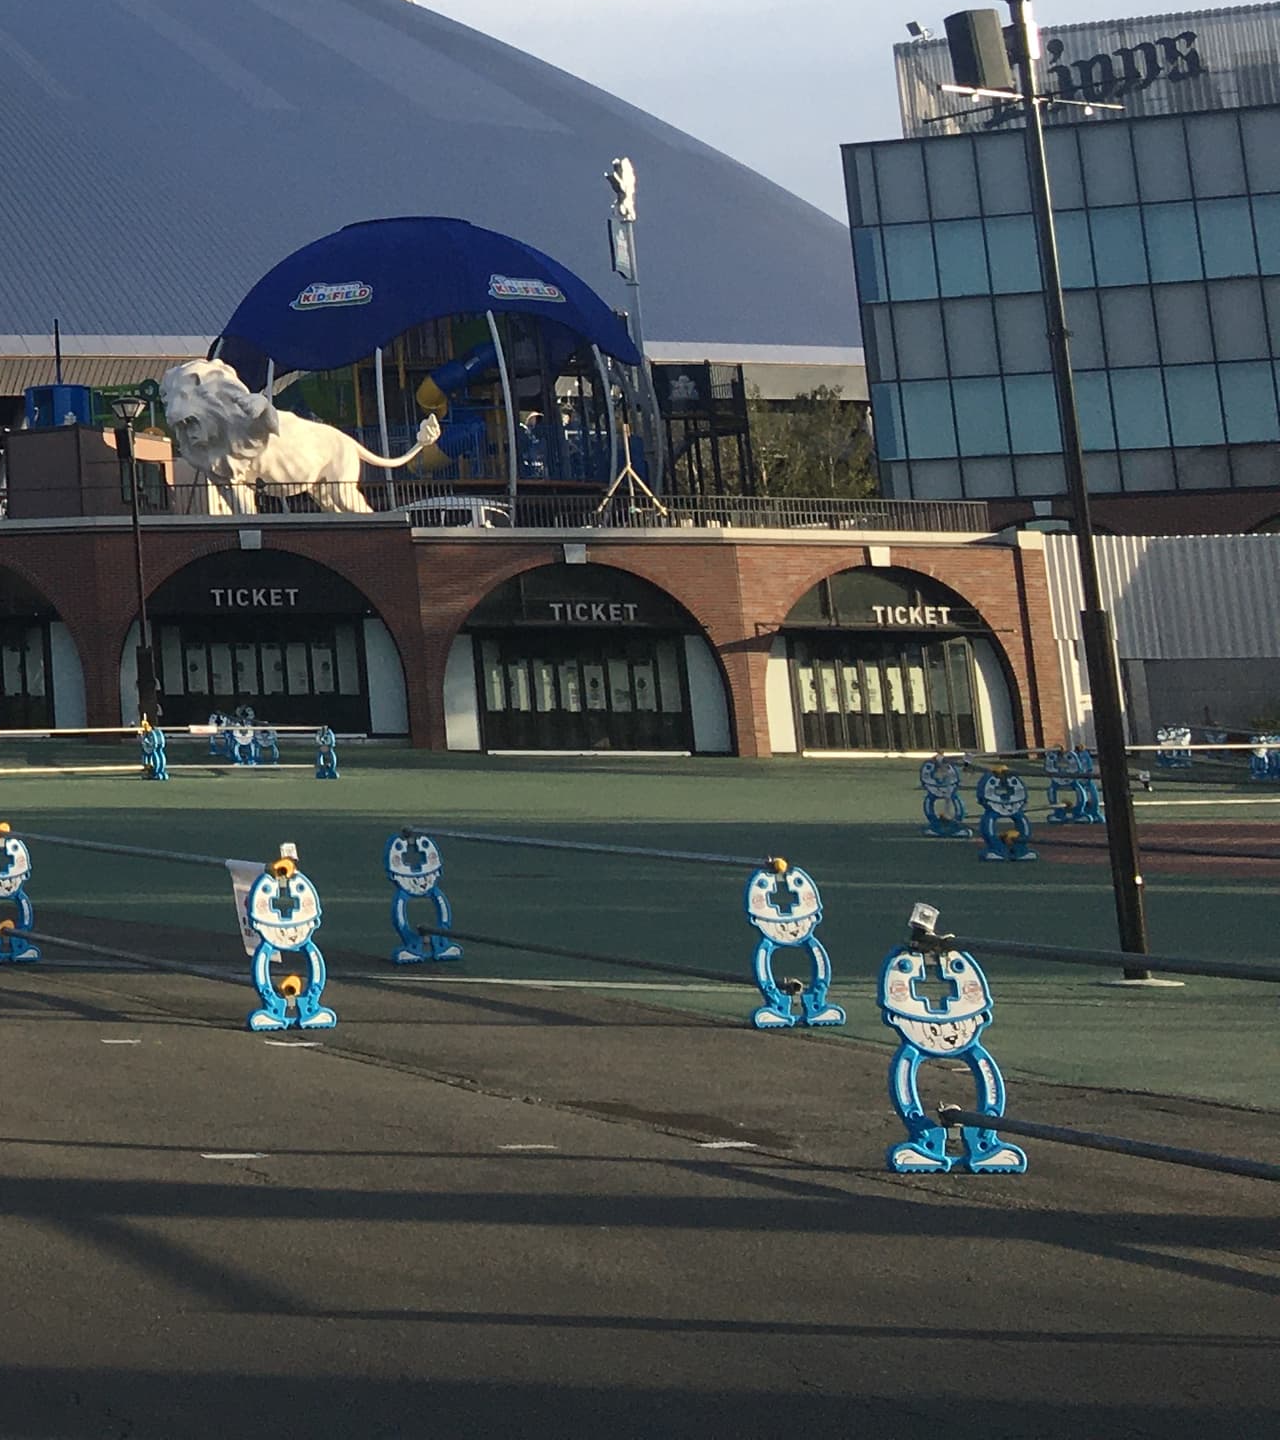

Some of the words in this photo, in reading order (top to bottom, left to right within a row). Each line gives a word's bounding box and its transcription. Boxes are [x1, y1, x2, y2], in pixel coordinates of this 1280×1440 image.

[210, 588, 299, 607] TICKET
[549, 603, 638, 622] TICKET
[872, 605, 951, 625] TICKET
